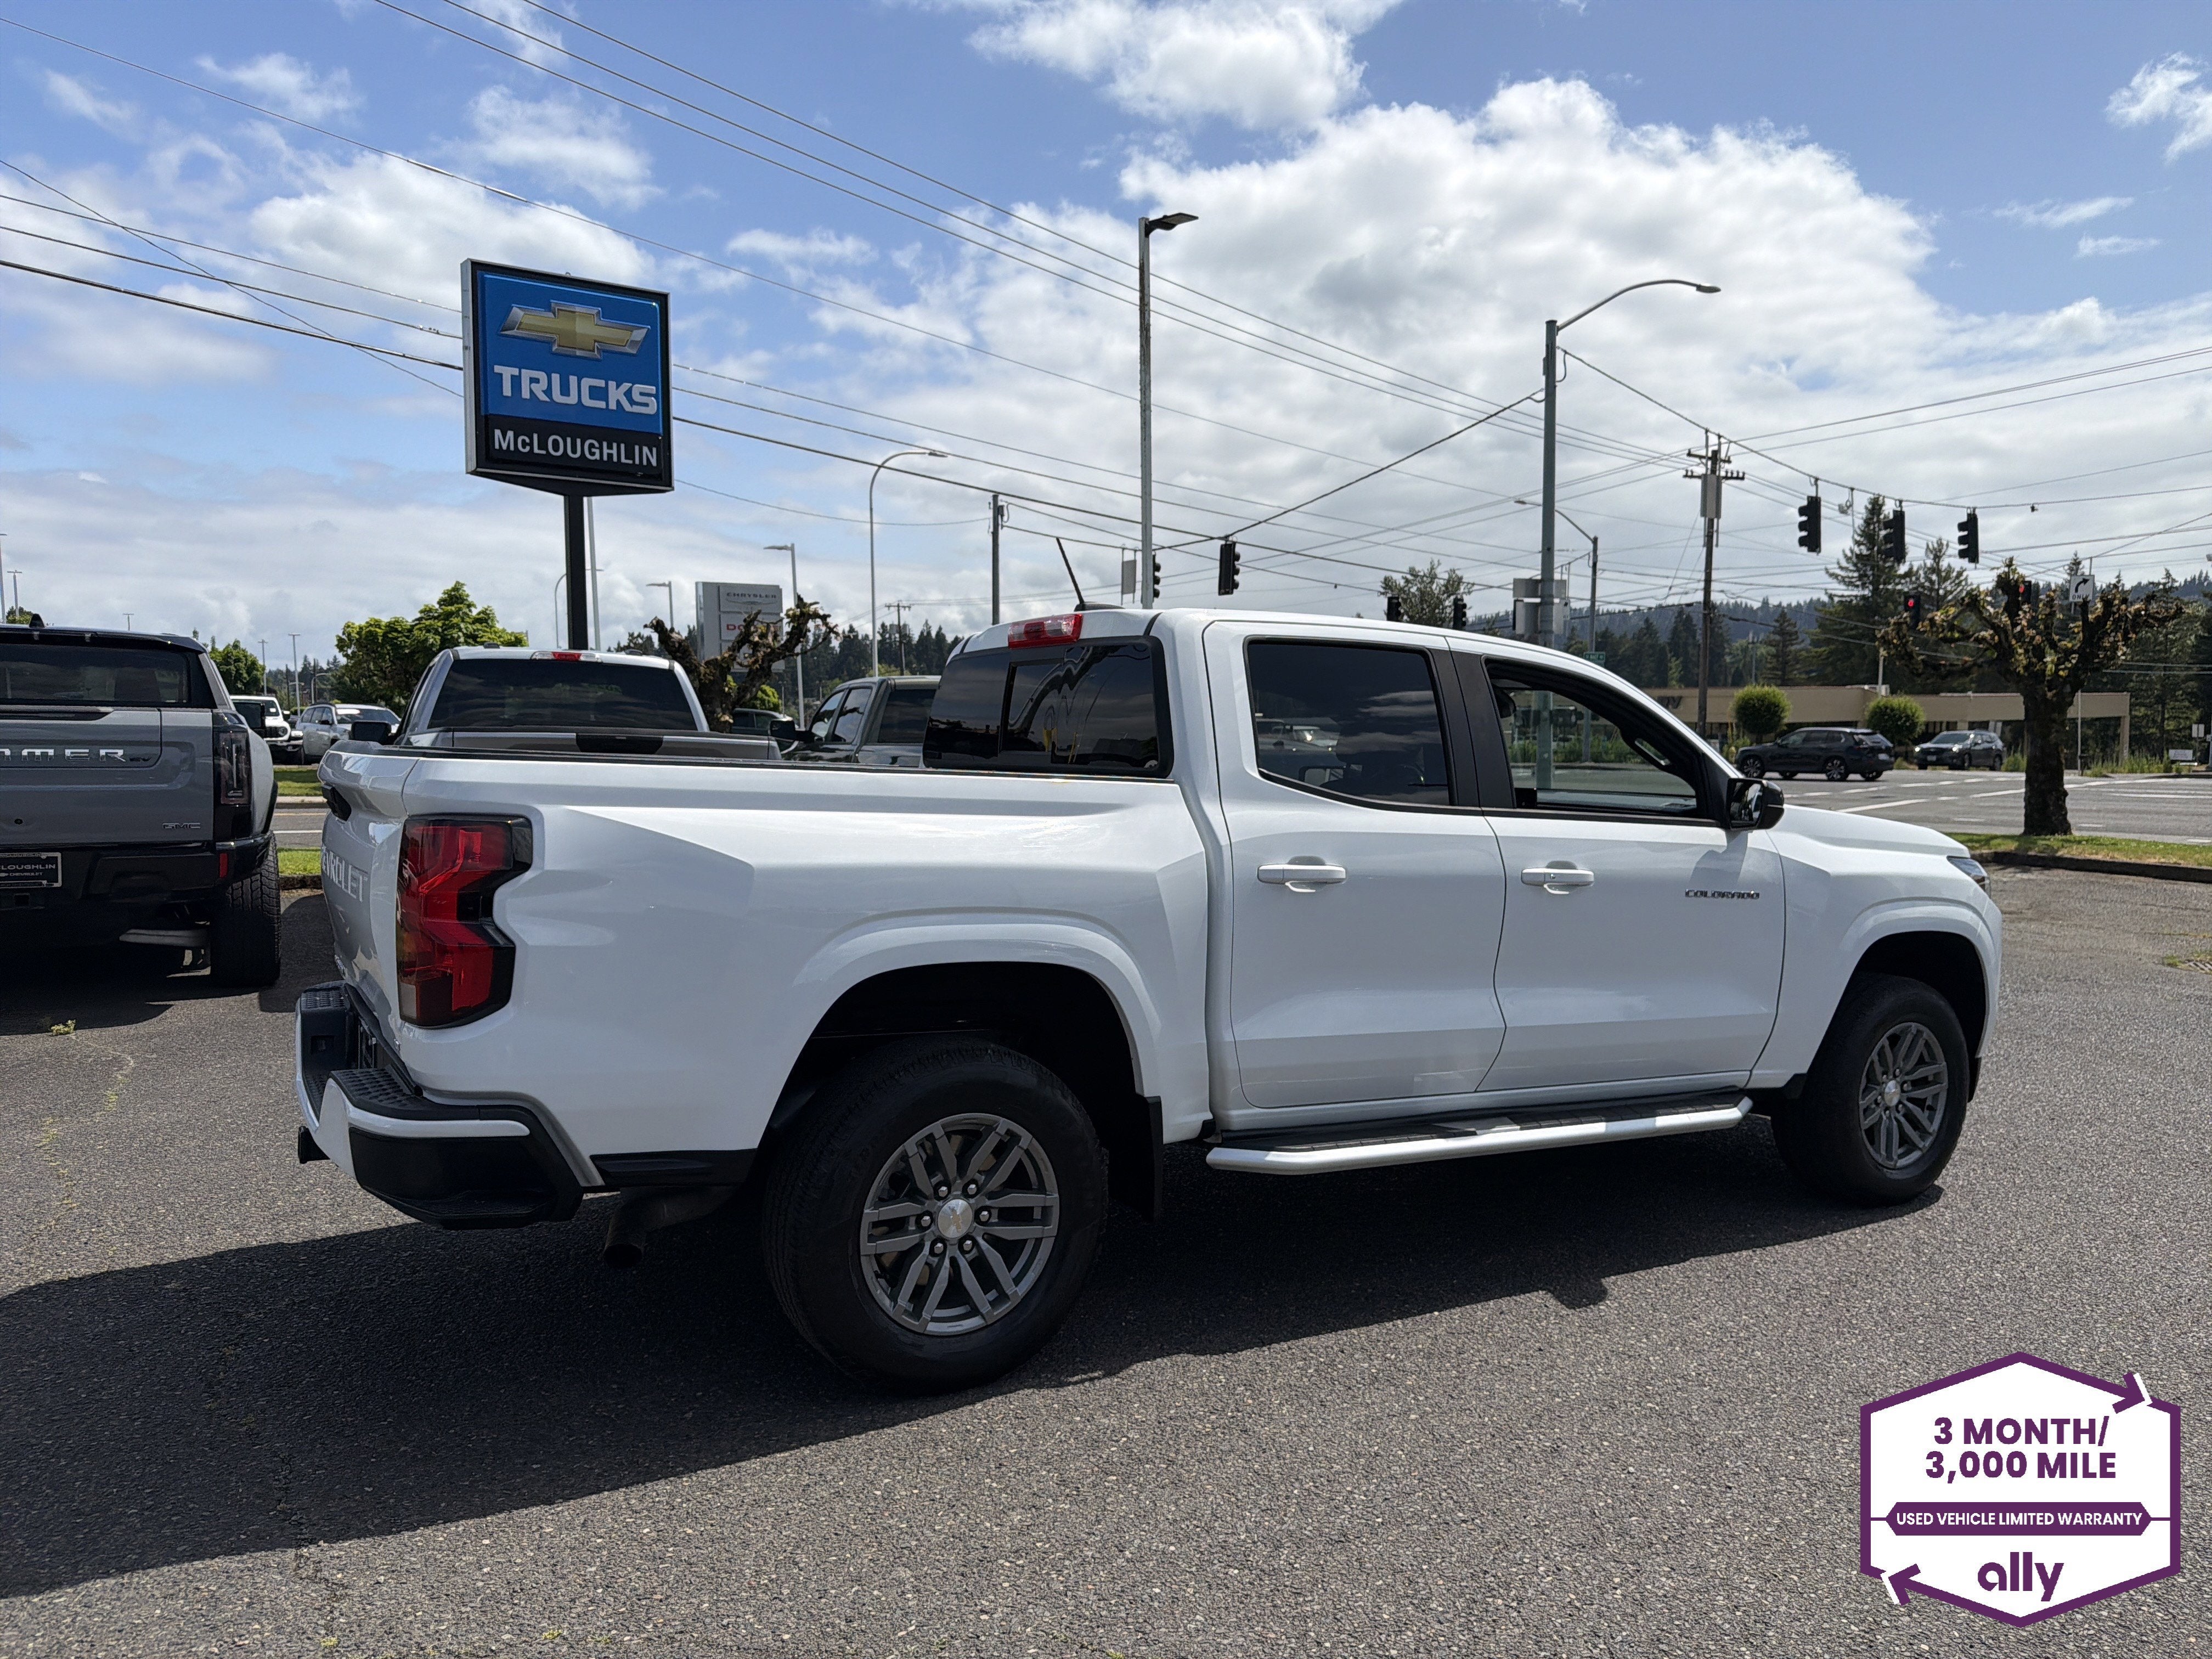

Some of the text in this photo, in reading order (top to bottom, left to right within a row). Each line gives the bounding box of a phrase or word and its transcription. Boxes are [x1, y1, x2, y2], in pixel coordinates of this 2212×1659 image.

[494, 365, 657, 415] TRUCKS
[494, 428, 657, 467] McLOUGHLIN
[321, 844, 369, 902] EVROLET
[1685, 890, 1760, 899] COLORADO
